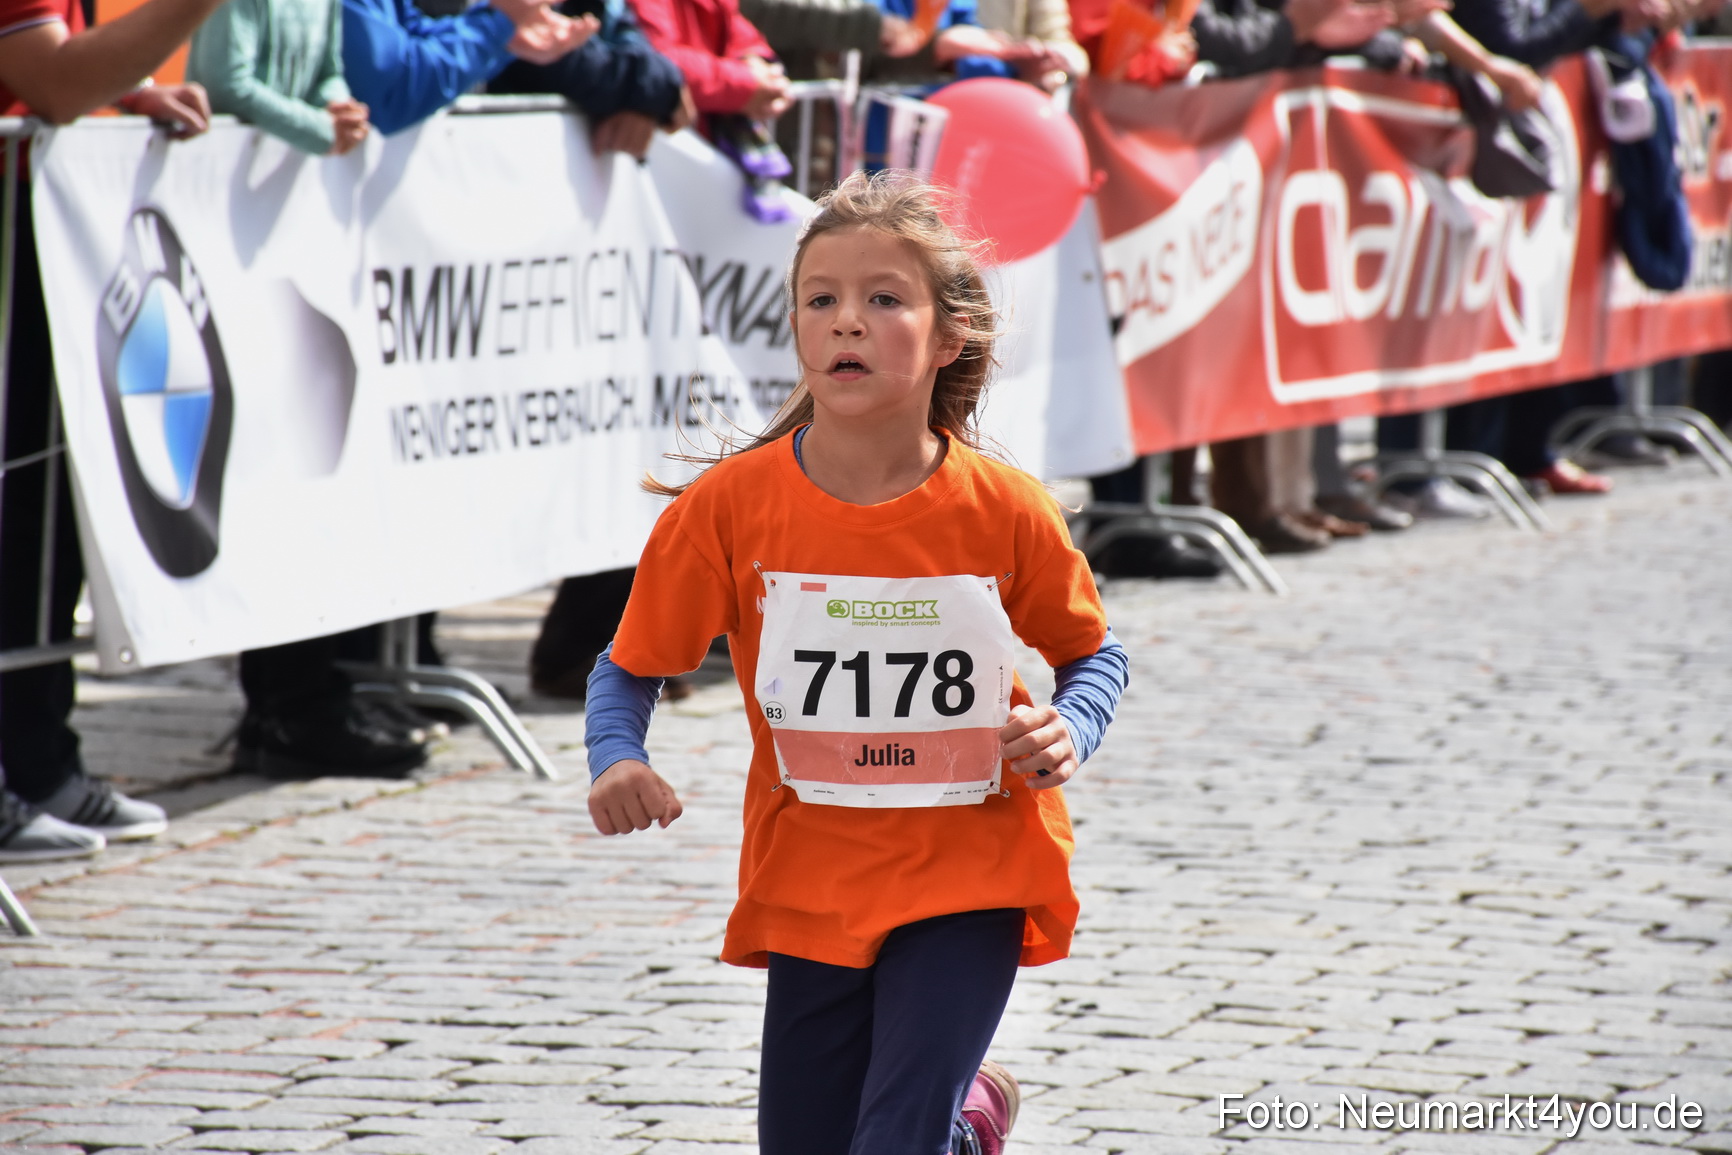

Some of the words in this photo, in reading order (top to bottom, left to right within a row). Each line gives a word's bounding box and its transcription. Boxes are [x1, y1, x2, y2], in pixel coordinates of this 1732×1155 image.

[852, 600, 939, 619] BOCK
[794, 649, 975, 718] 7178
[766, 707, 782, 719] B3
[854, 743, 915, 767] Julia
